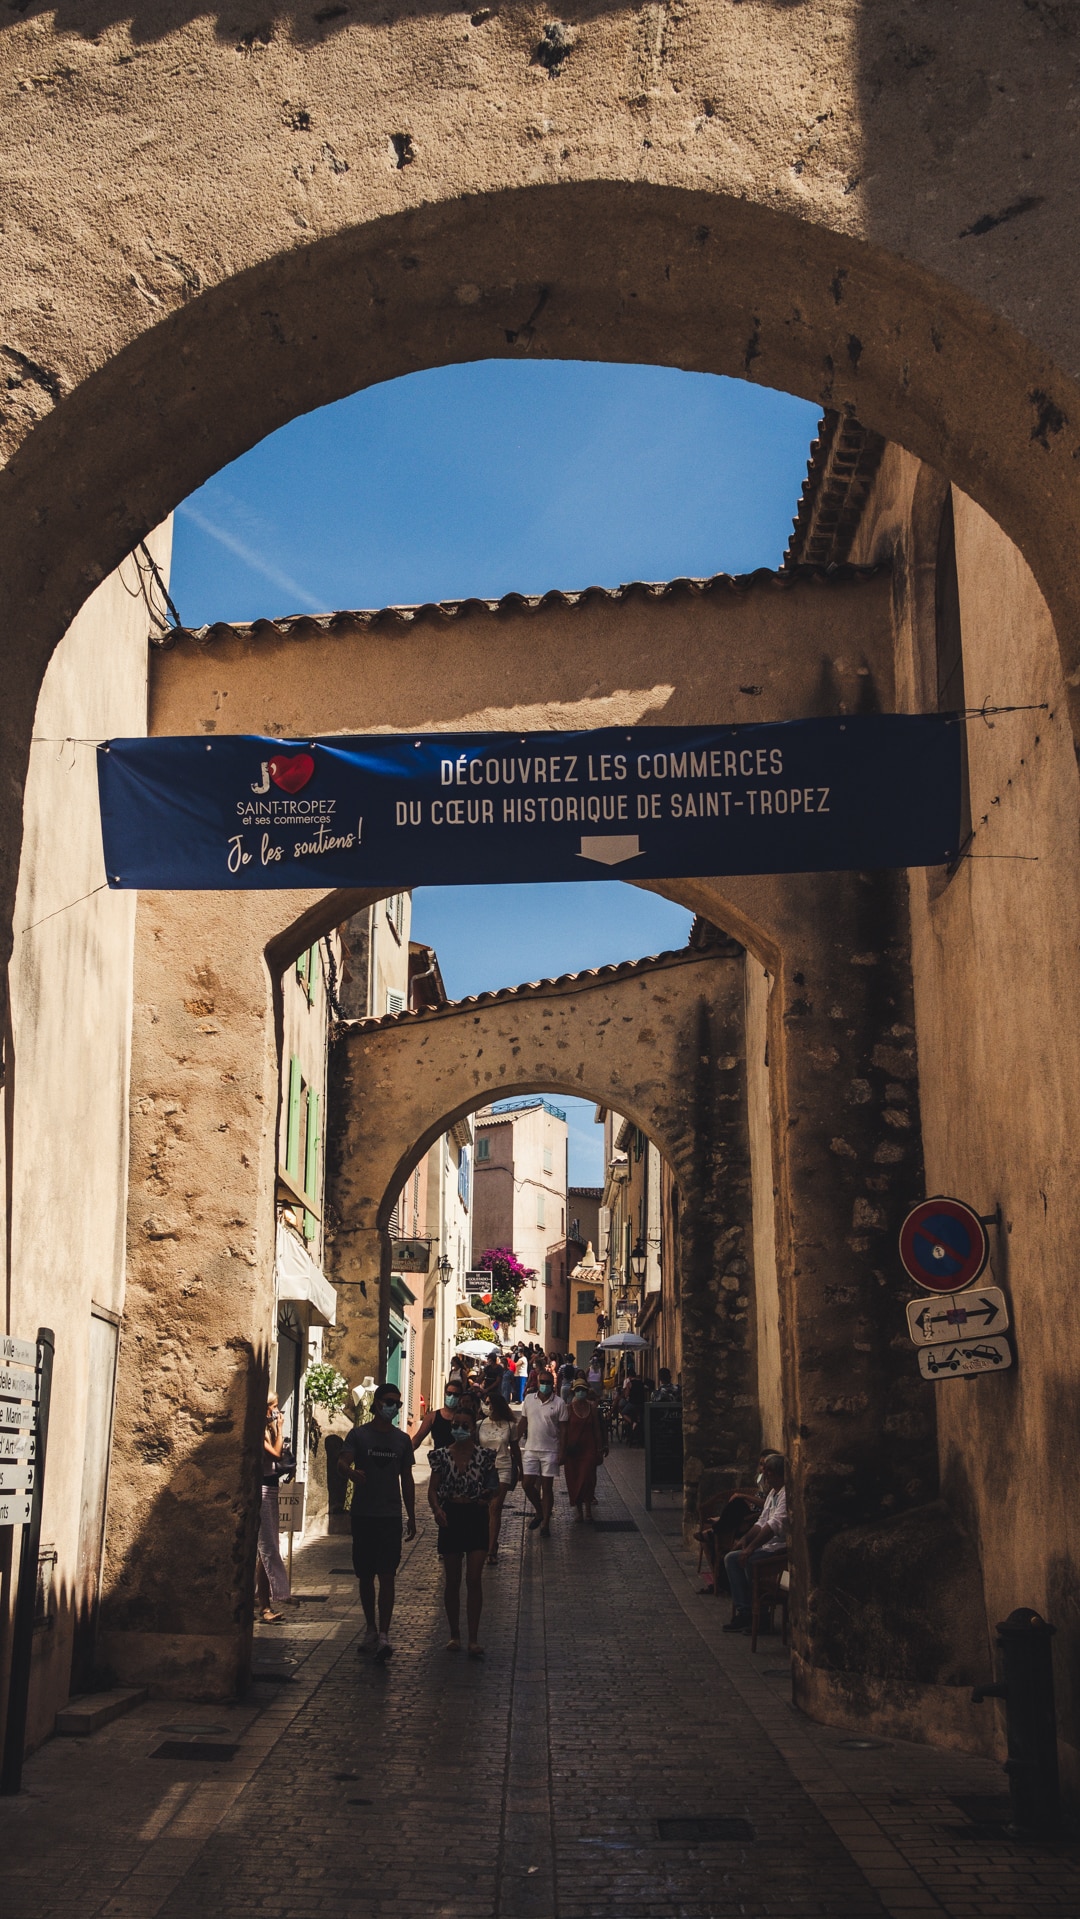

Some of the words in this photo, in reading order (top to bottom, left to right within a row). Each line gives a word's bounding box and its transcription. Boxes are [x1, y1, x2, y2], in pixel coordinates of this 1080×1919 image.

[441, 754, 578, 786] DÉCOUVREZ
[588, 754, 627, 781] LES
[637, 749, 783, 779] COMMERCES
[236, 800, 336, 815] SAINT-TROPEZ
[396, 801, 422, 826] DU
[431, 799, 494, 825] CŒUR
[503, 795, 628, 823] HISTORIQUE
[637, 794, 662, 819] DE
[670, 787, 830, 818] SAINT-TROPEZ
[242, 815, 252, 825] et
[255, 816, 271, 825] ses
[273, 815, 331, 824] commerces
[227, 834, 252, 872] Je
[261, 832, 284, 866] les
[3, 1339, 15, 1358] Ville
[6, 1407, 21, 1424] Marin
